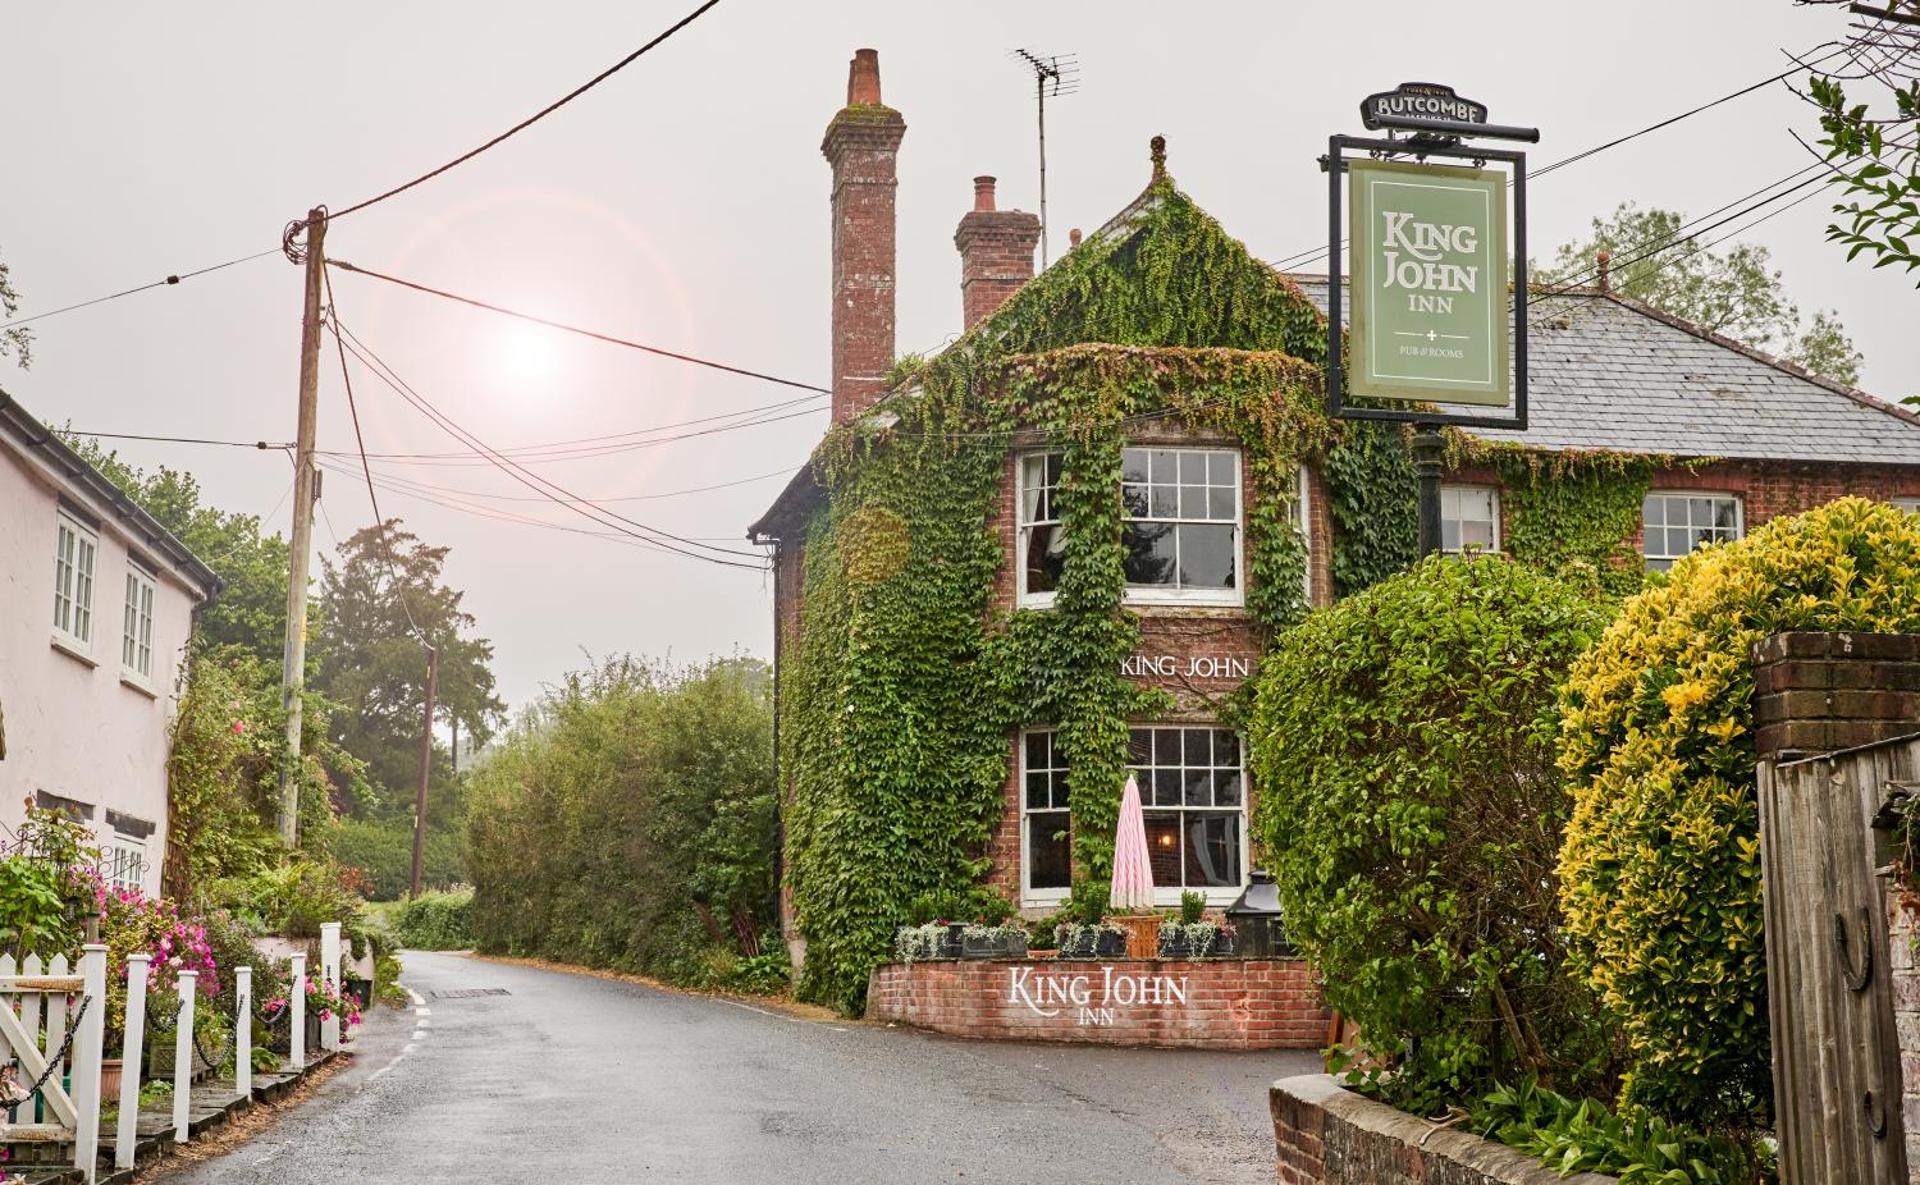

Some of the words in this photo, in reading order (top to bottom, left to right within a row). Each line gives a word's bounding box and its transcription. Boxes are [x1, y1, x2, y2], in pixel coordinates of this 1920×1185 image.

[1382, 211, 1478, 261] KING
[1383, 251, 1478, 293] JOHN
[1408, 294, 1454, 314] INN
[1400, 345, 1418, 356] PUB
[1429, 347, 1464, 359] ROOMS
[1120, 655, 1176, 676] KING
[1183, 656, 1249, 678] JOHN
[1008, 966, 1092, 1017] KING
[1101, 966, 1188, 1006] JOHN
[1078, 1007, 1114, 1026] INN
